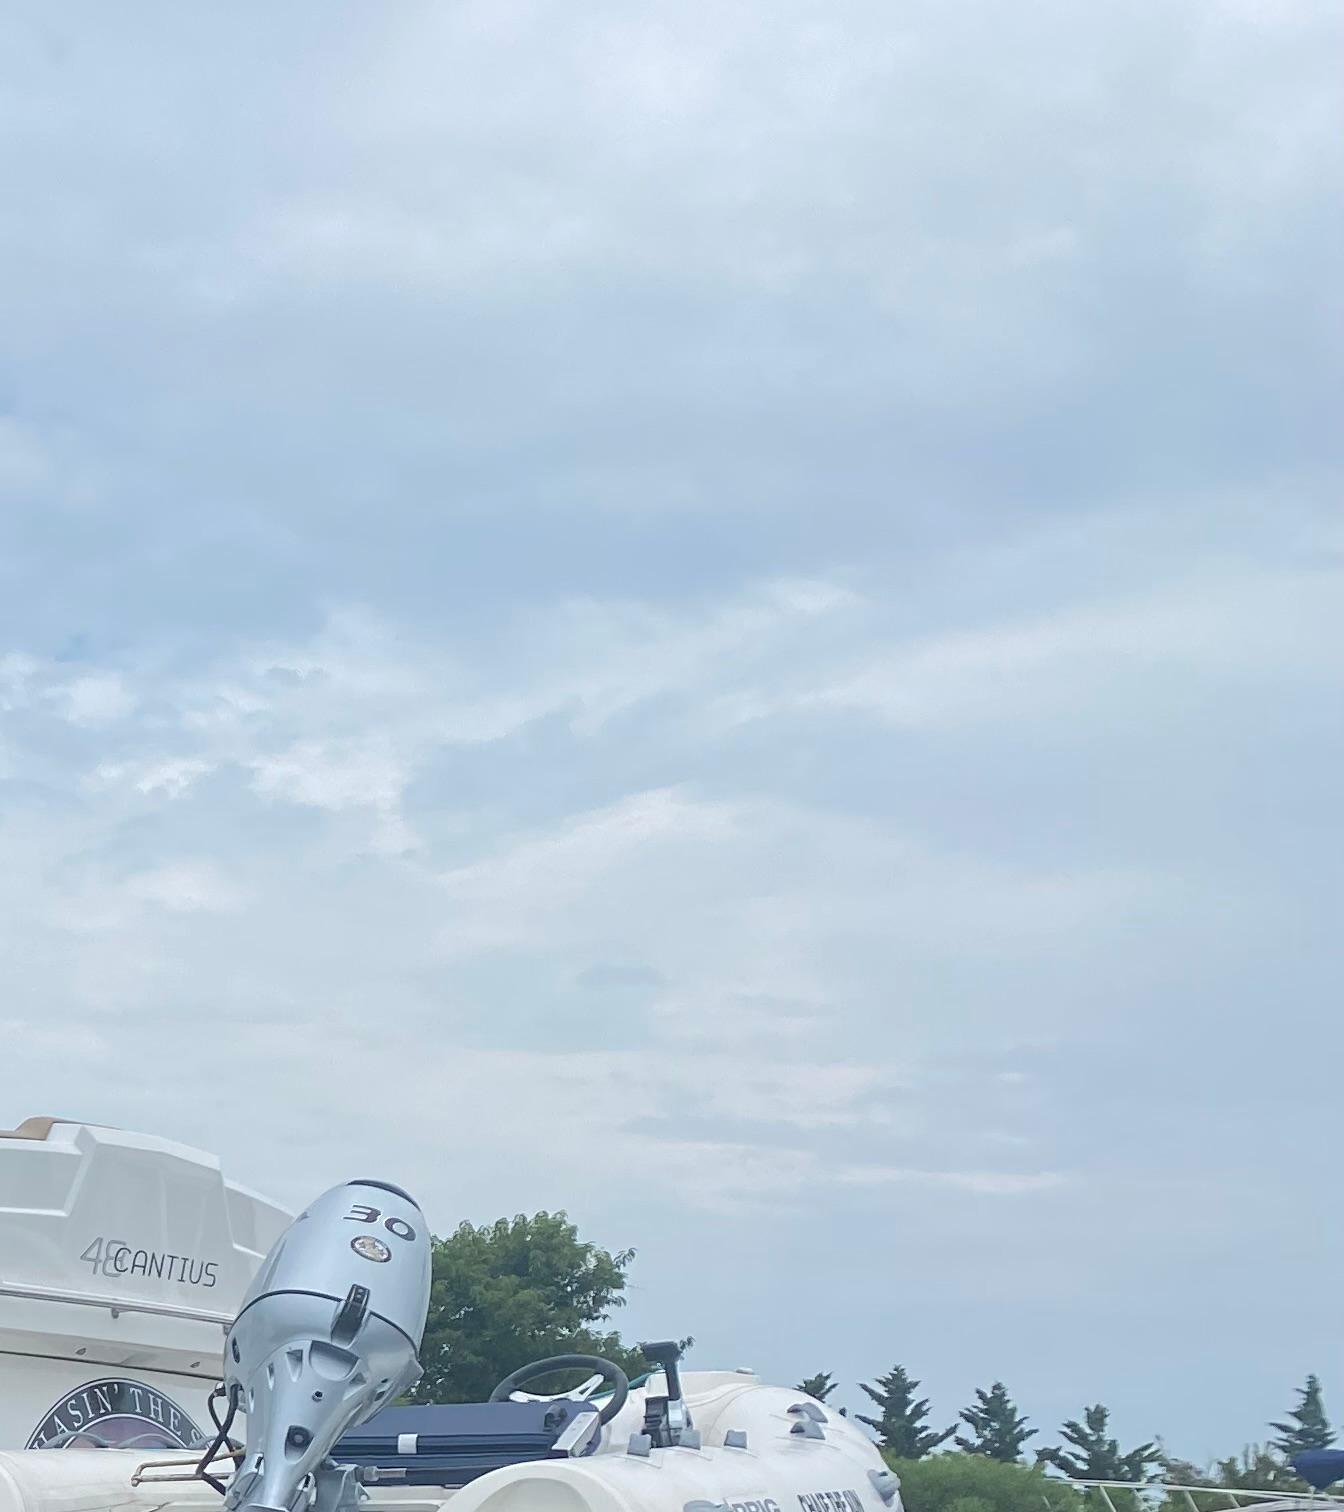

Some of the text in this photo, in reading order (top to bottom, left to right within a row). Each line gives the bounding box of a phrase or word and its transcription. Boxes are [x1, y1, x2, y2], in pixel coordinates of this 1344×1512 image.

[342, 1204, 417, 1242] 30
[113, 1247, 219, 1288] CANTIUS
[32, 1383, 183, 1450] ASIN' THE
